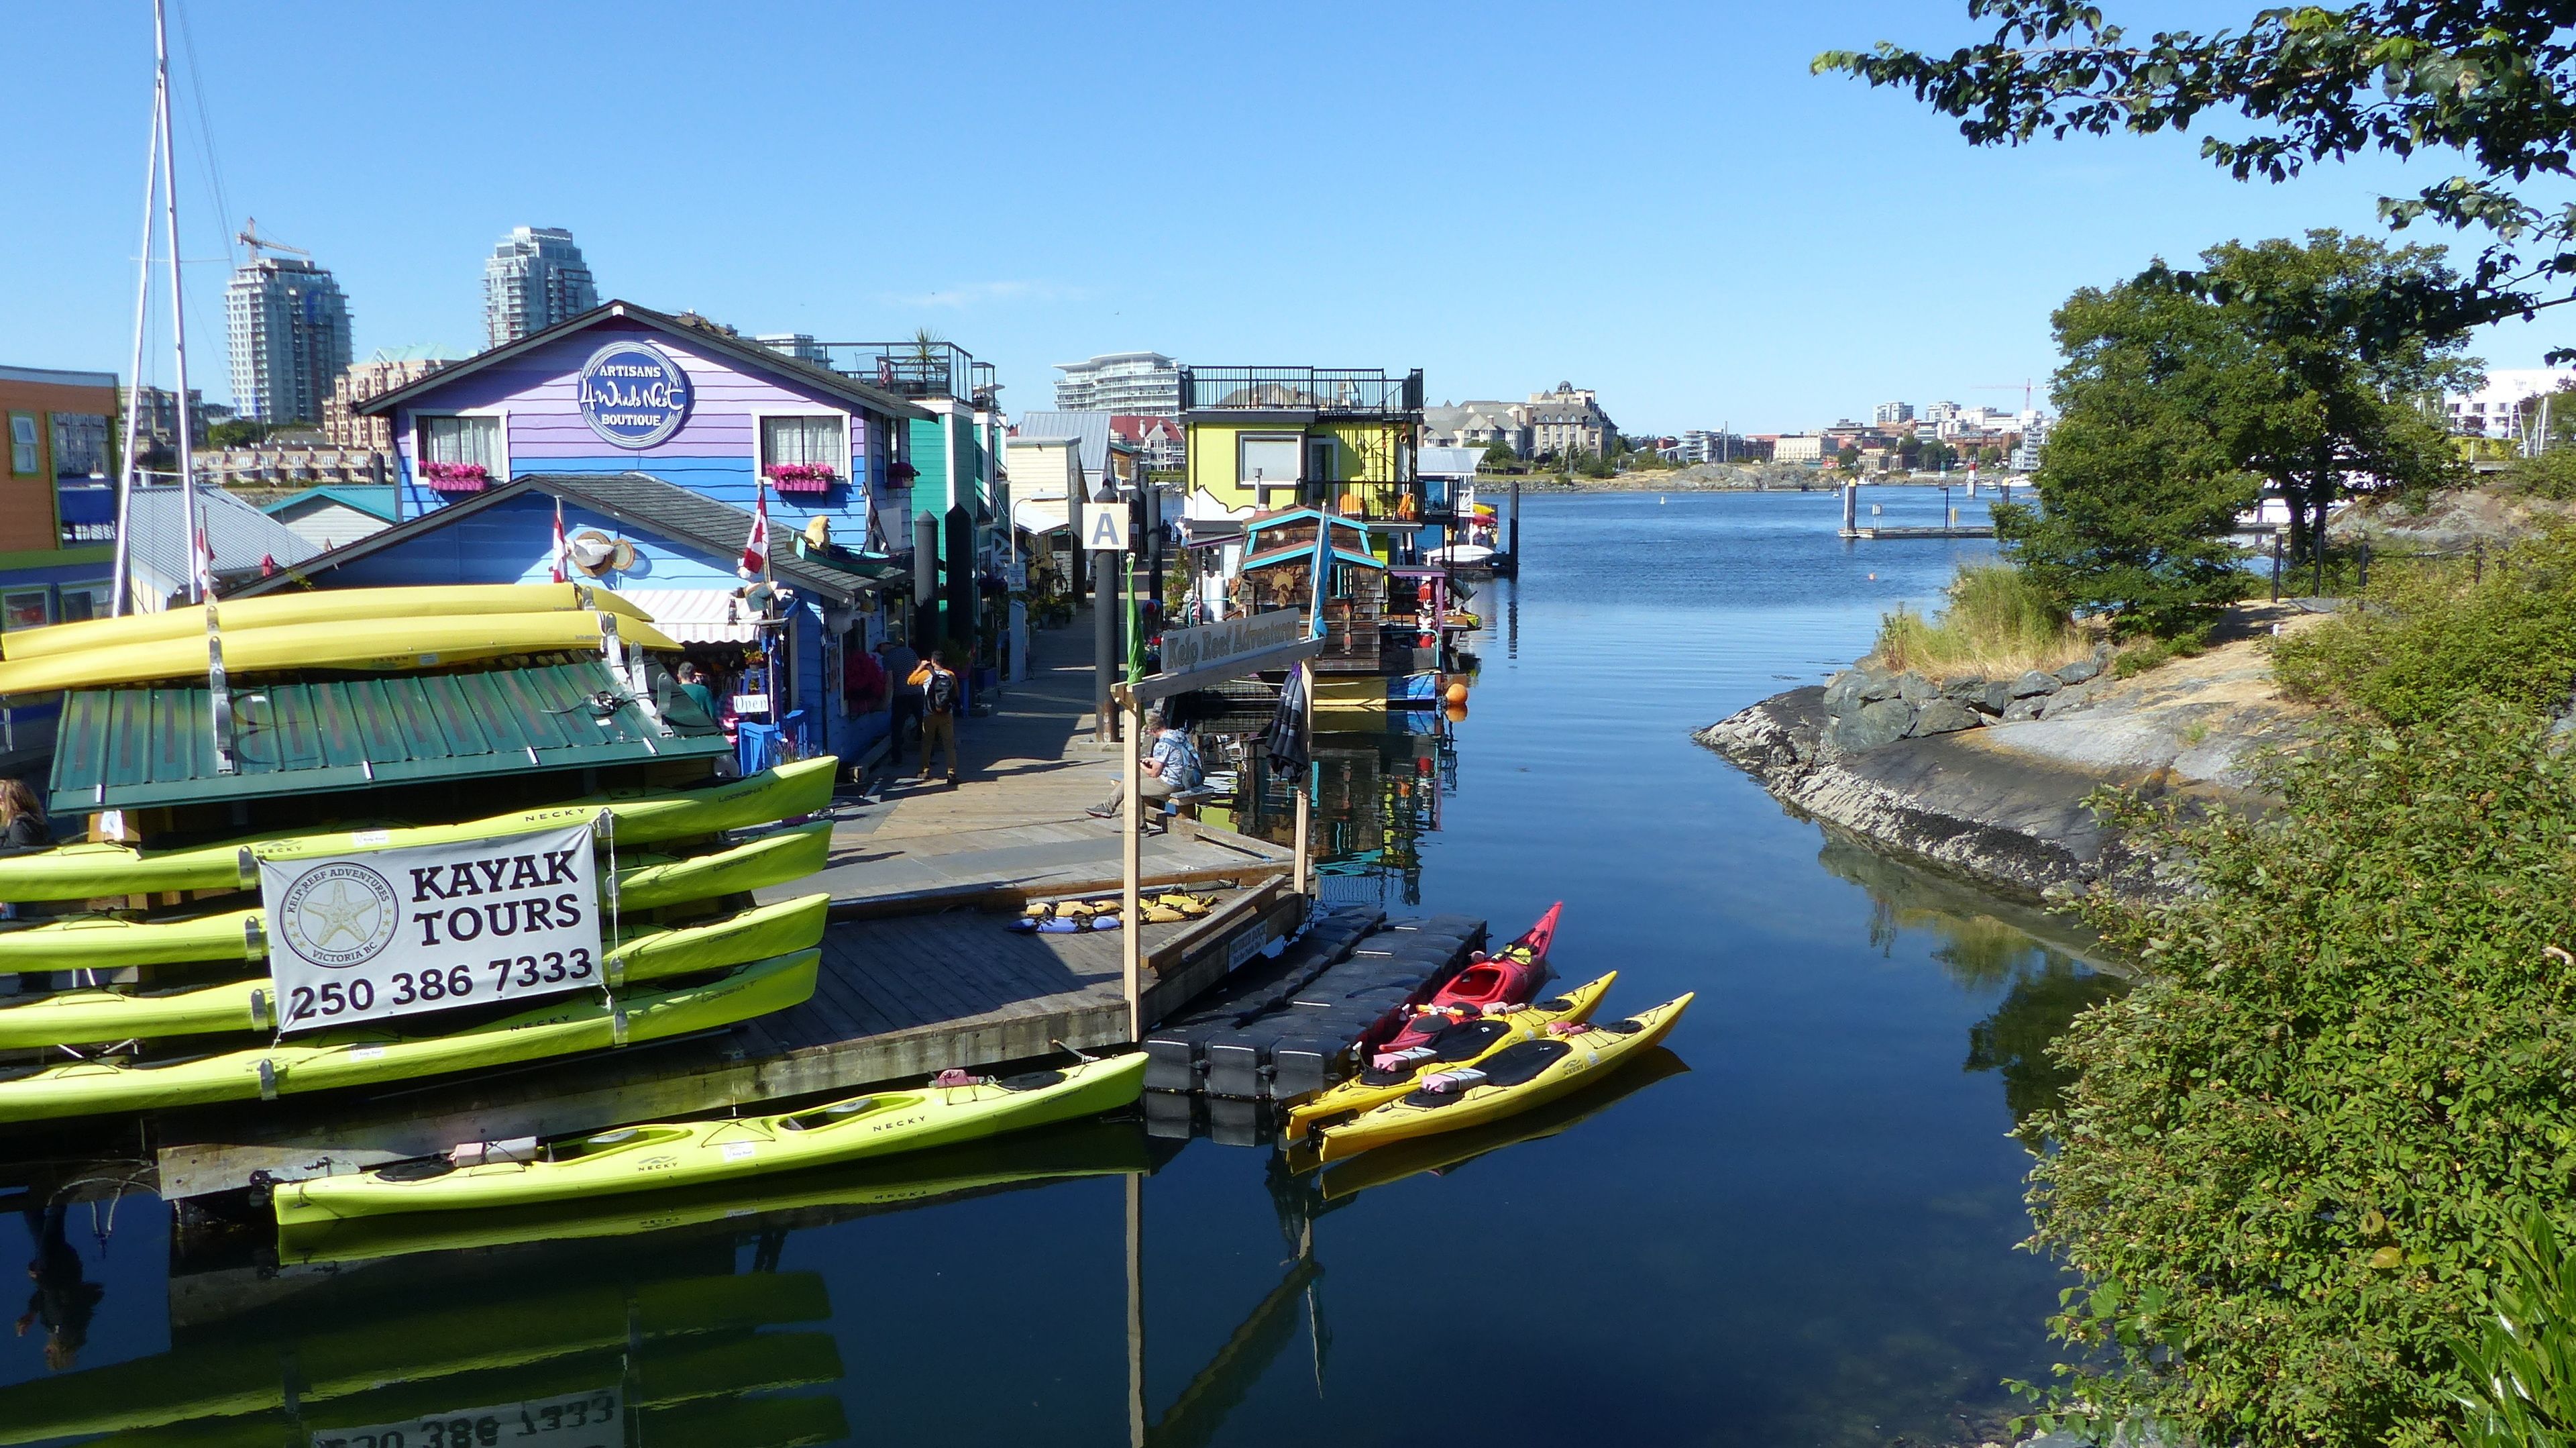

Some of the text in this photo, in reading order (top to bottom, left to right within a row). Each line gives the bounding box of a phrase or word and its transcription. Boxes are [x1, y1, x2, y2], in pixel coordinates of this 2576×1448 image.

[600, 366, 661, 378] ARTISANS
[580, 378, 684, 411] 4 Winds Nest
[601, 414, 661, 426] BOUTIQUE
[1092, 513, 1120, 545] A
[1167, 621, 1297, 671] Kelp Reef Adventures
[735, 695, 767, 713] Open
[525, 809, 585, 822] NECKY
[257, 846, 302, 854] NECKY
[409, 849, 578, 902] KAYAK
[287, 868, 390, 913] KELP REEF ADVENTURES
[413, 893, 582, 947] TOURS
[312, 942, 378, 962] VICTORIA BC
[290, 948, 593, 1020] 250 386 7333
[510, 1015, 570, 1032] NECKY
[873, 1115, 925, 1132] NECKY
[639, 1162, 678, 1172] NECKY
